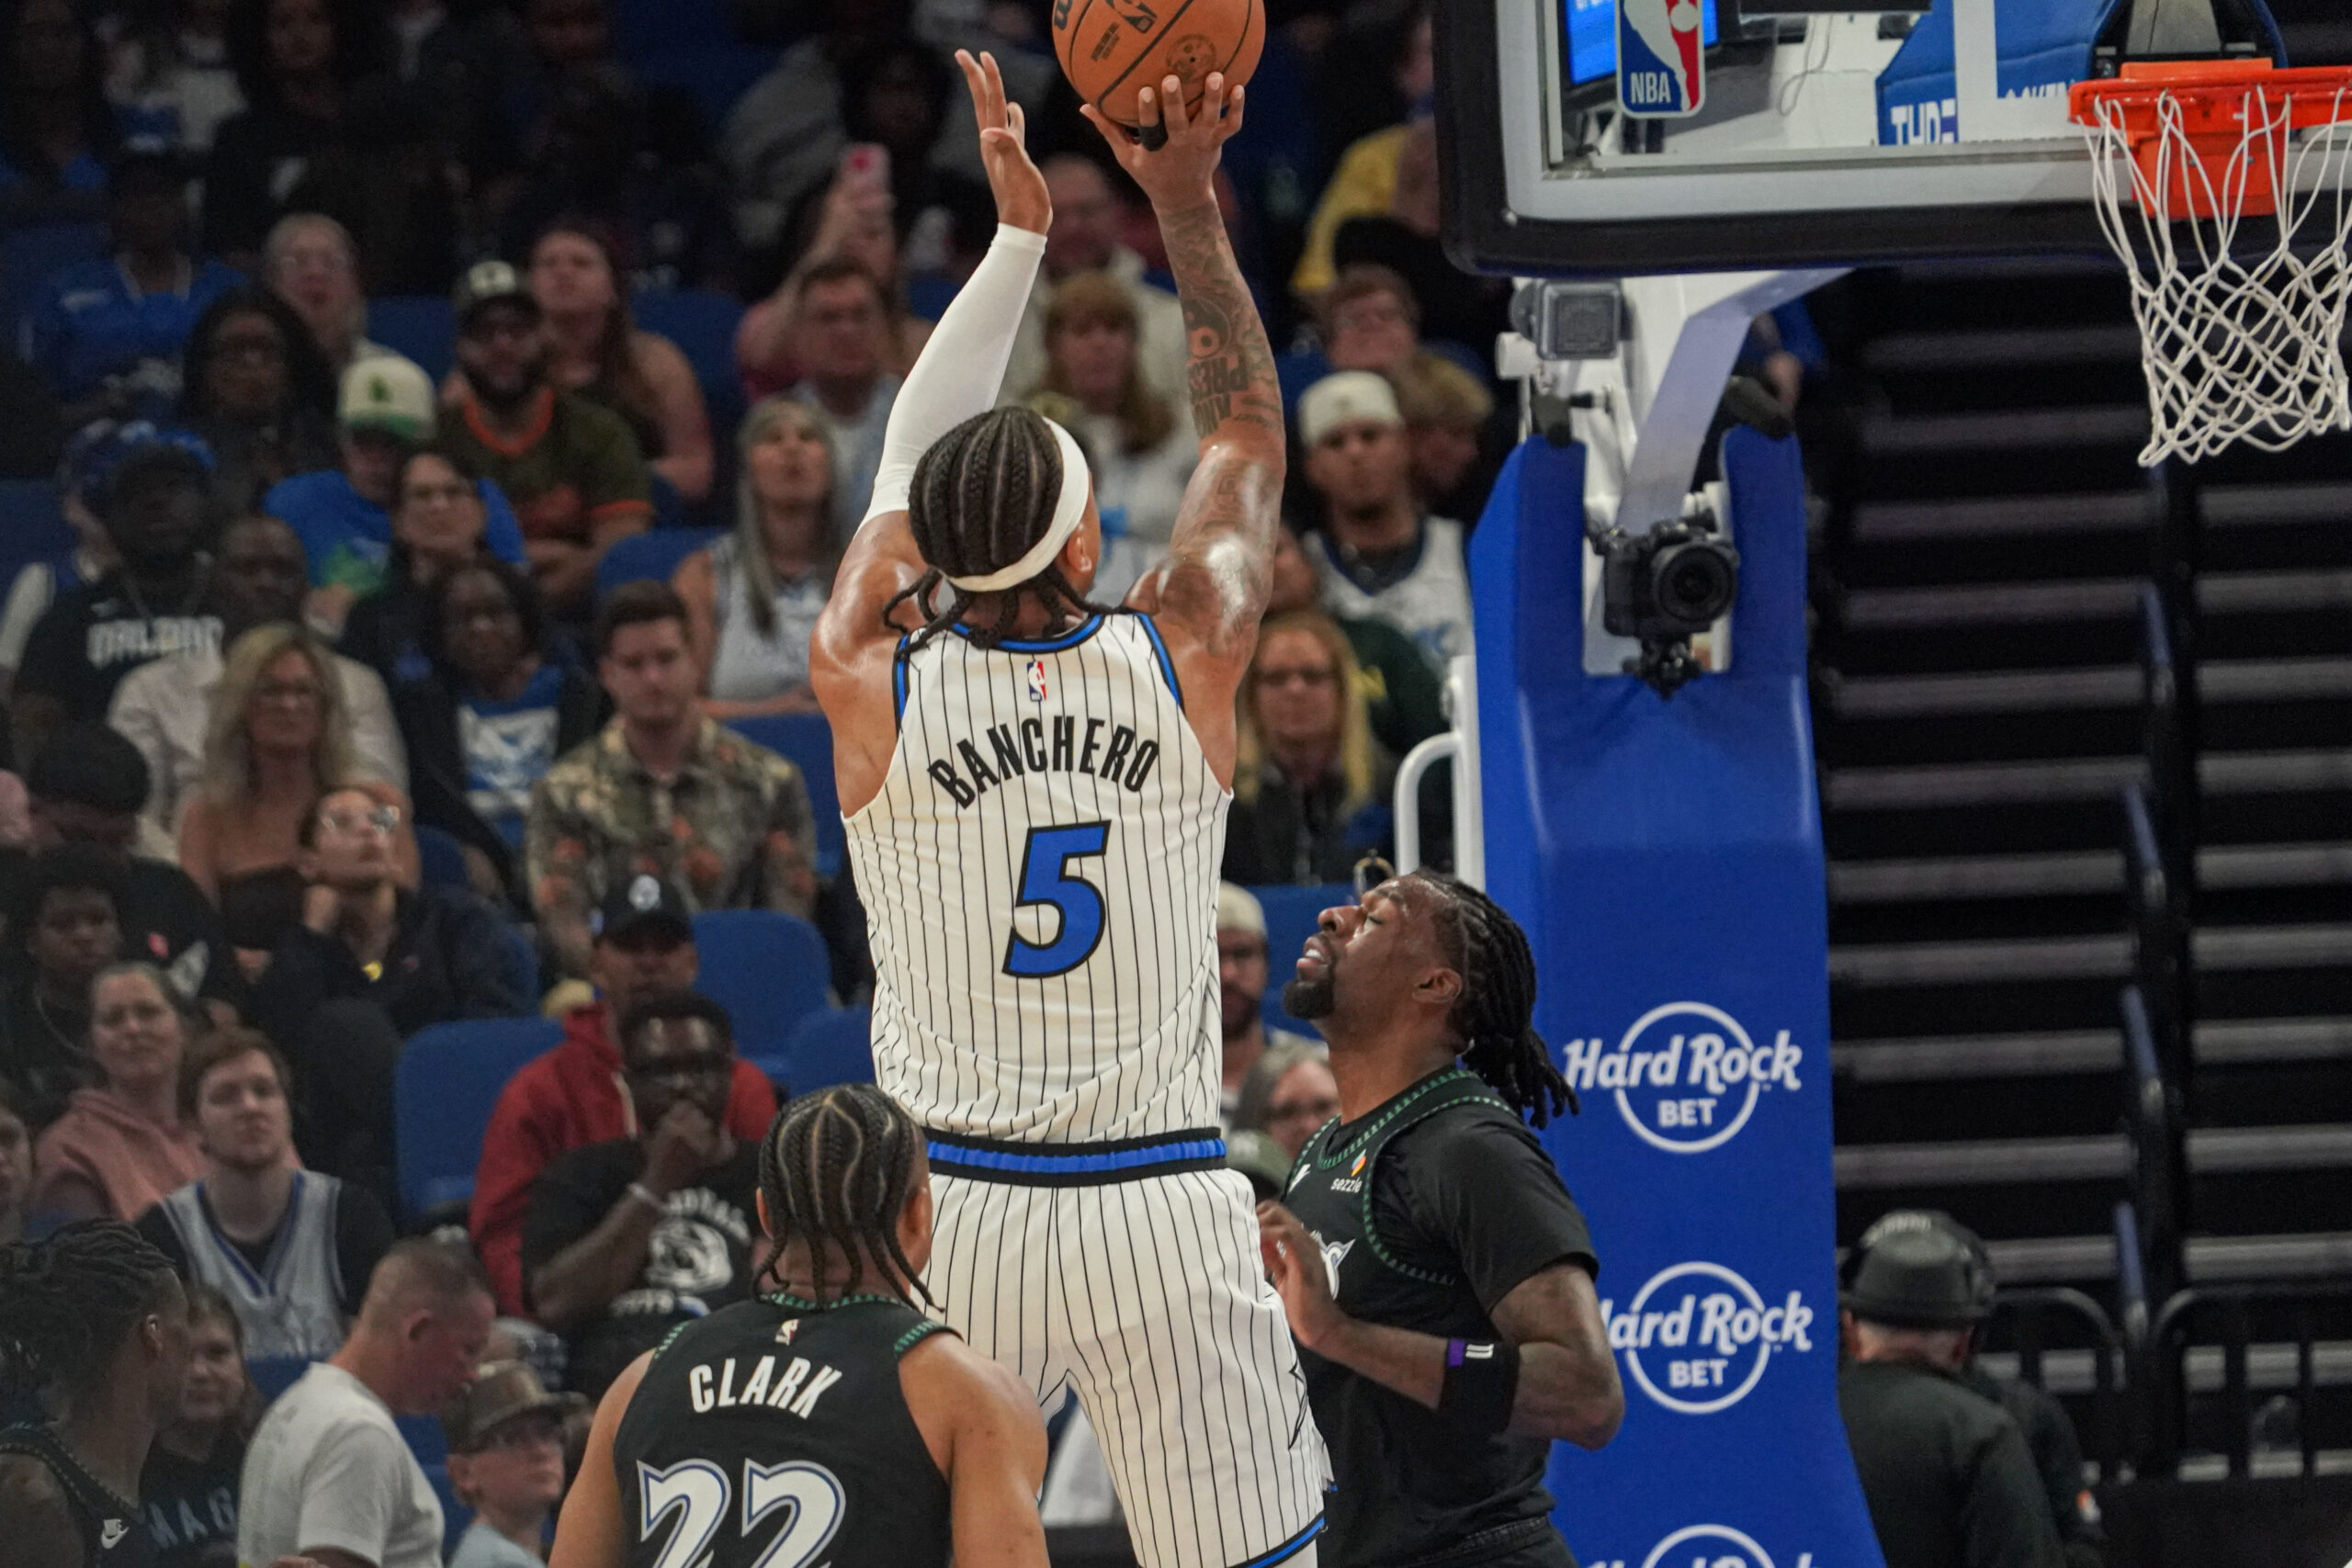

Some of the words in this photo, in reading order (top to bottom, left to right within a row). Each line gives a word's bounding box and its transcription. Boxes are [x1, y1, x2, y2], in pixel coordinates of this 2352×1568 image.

[1630, 72, 1671, 104] NBA
[927, 716, 1159, 810] BANCHERO
[1001, 819, 1113, 979] 5
[1563, 1034, 1685, 1089] Hard
[1687, 1029, 1803, 1095] Rock
[1658, 1098, 1717, 1127] BET
[1330, 1176, 1363, 1194] sezzle
[1700, 1290, 1814, 1356] Rock
[689, 1355, 843, 1420] CLARK
[1668, 1359, 1729, 1388] BET
[636, 1457, 847, 1568] 22
